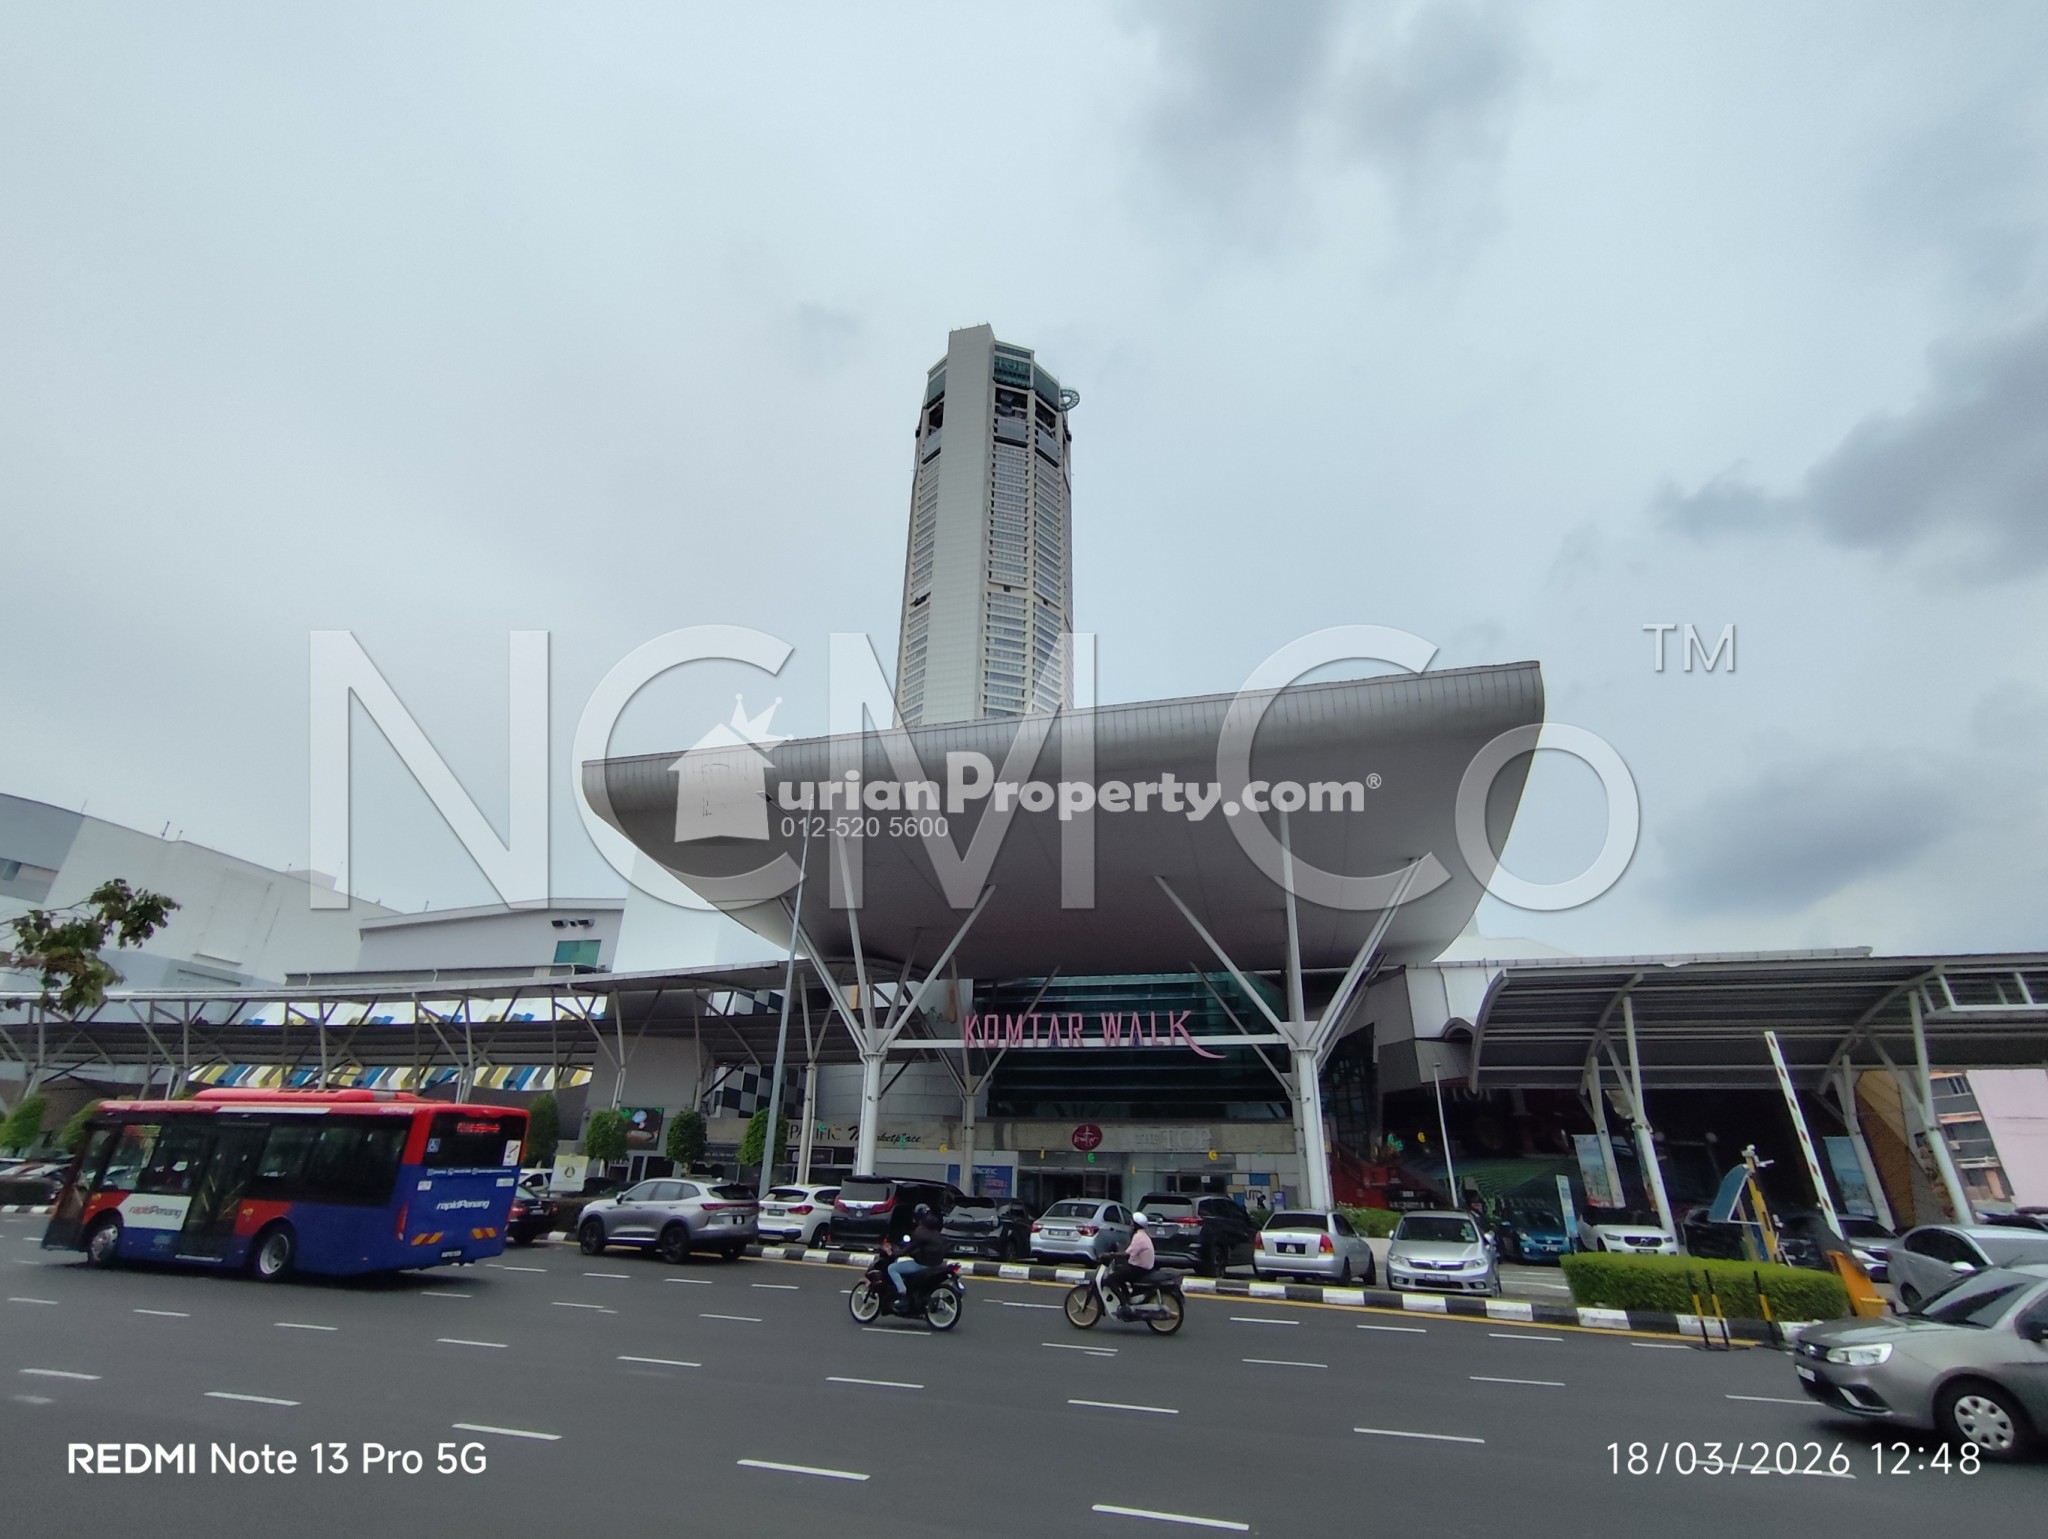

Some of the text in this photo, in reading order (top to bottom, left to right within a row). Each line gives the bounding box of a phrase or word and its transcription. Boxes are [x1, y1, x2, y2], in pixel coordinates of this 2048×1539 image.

[963, 1010, 1228, 1059] KOMTAR WALK
[129, 1205, 182, 1219] rapidPenang
[436, 1200, 490, 1211] rapidPenang
